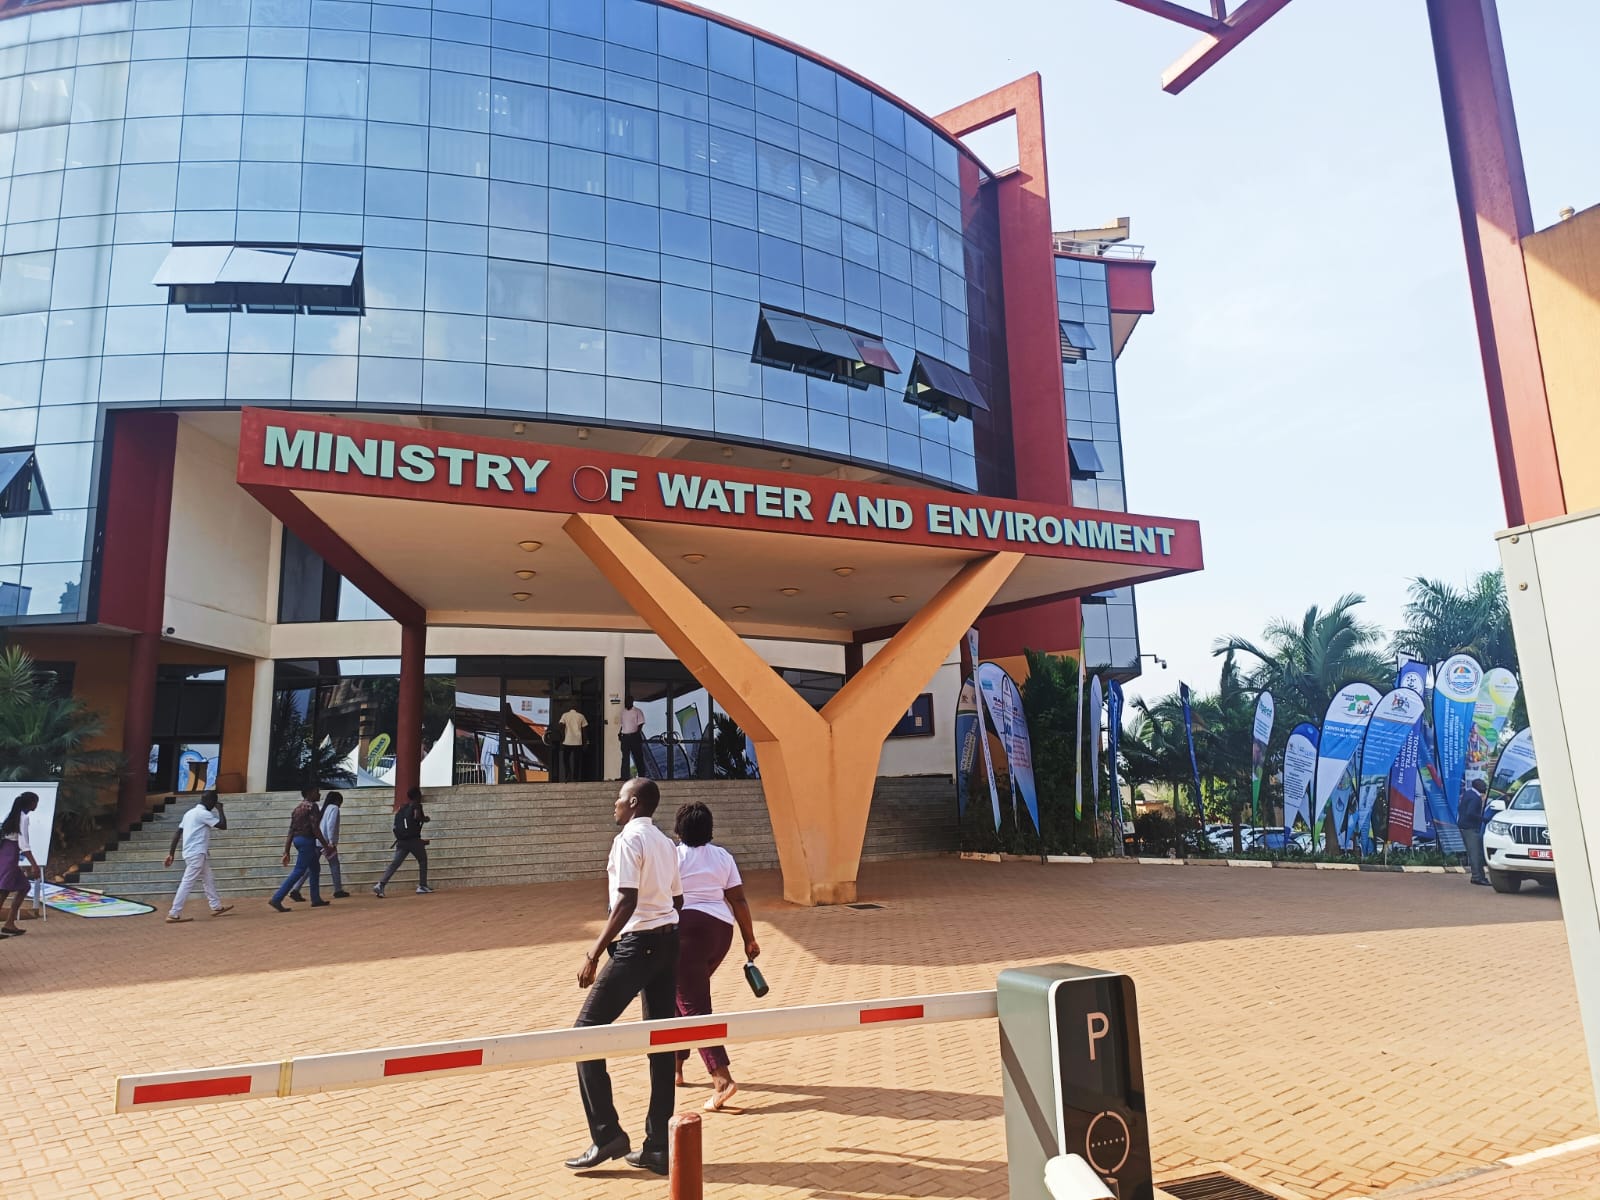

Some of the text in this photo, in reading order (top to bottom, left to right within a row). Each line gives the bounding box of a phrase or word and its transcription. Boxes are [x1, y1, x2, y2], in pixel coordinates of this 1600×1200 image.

[263, 425, 551, 494] MINISTRY
[656, 471, 814, 522] WATER
[826, 492, 914, 531] AND
[927, 502, 1176, 556] ENVIRONMENT
[1412, 735, 1420, 768] SCHOOL
[1087, 1012, 1110, 1061] P
